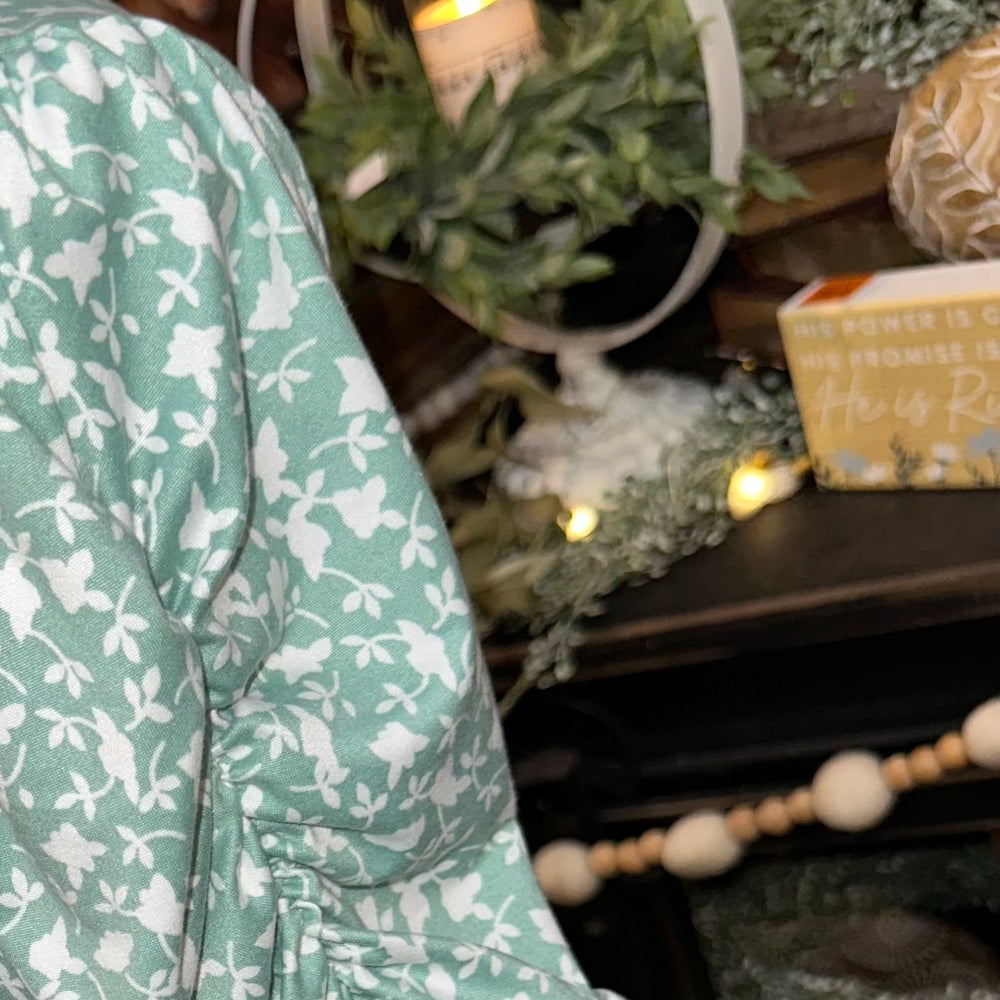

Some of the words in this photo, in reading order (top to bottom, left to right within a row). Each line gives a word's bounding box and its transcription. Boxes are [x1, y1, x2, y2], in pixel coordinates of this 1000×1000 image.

[793, 321, 834, 340] HIS
[842, 310, 936, 336] POWER
[946, 307, 974, 329] IS
[800, 352, 841, 371] HIS
[849, 341, 964, 368] PROMISE
